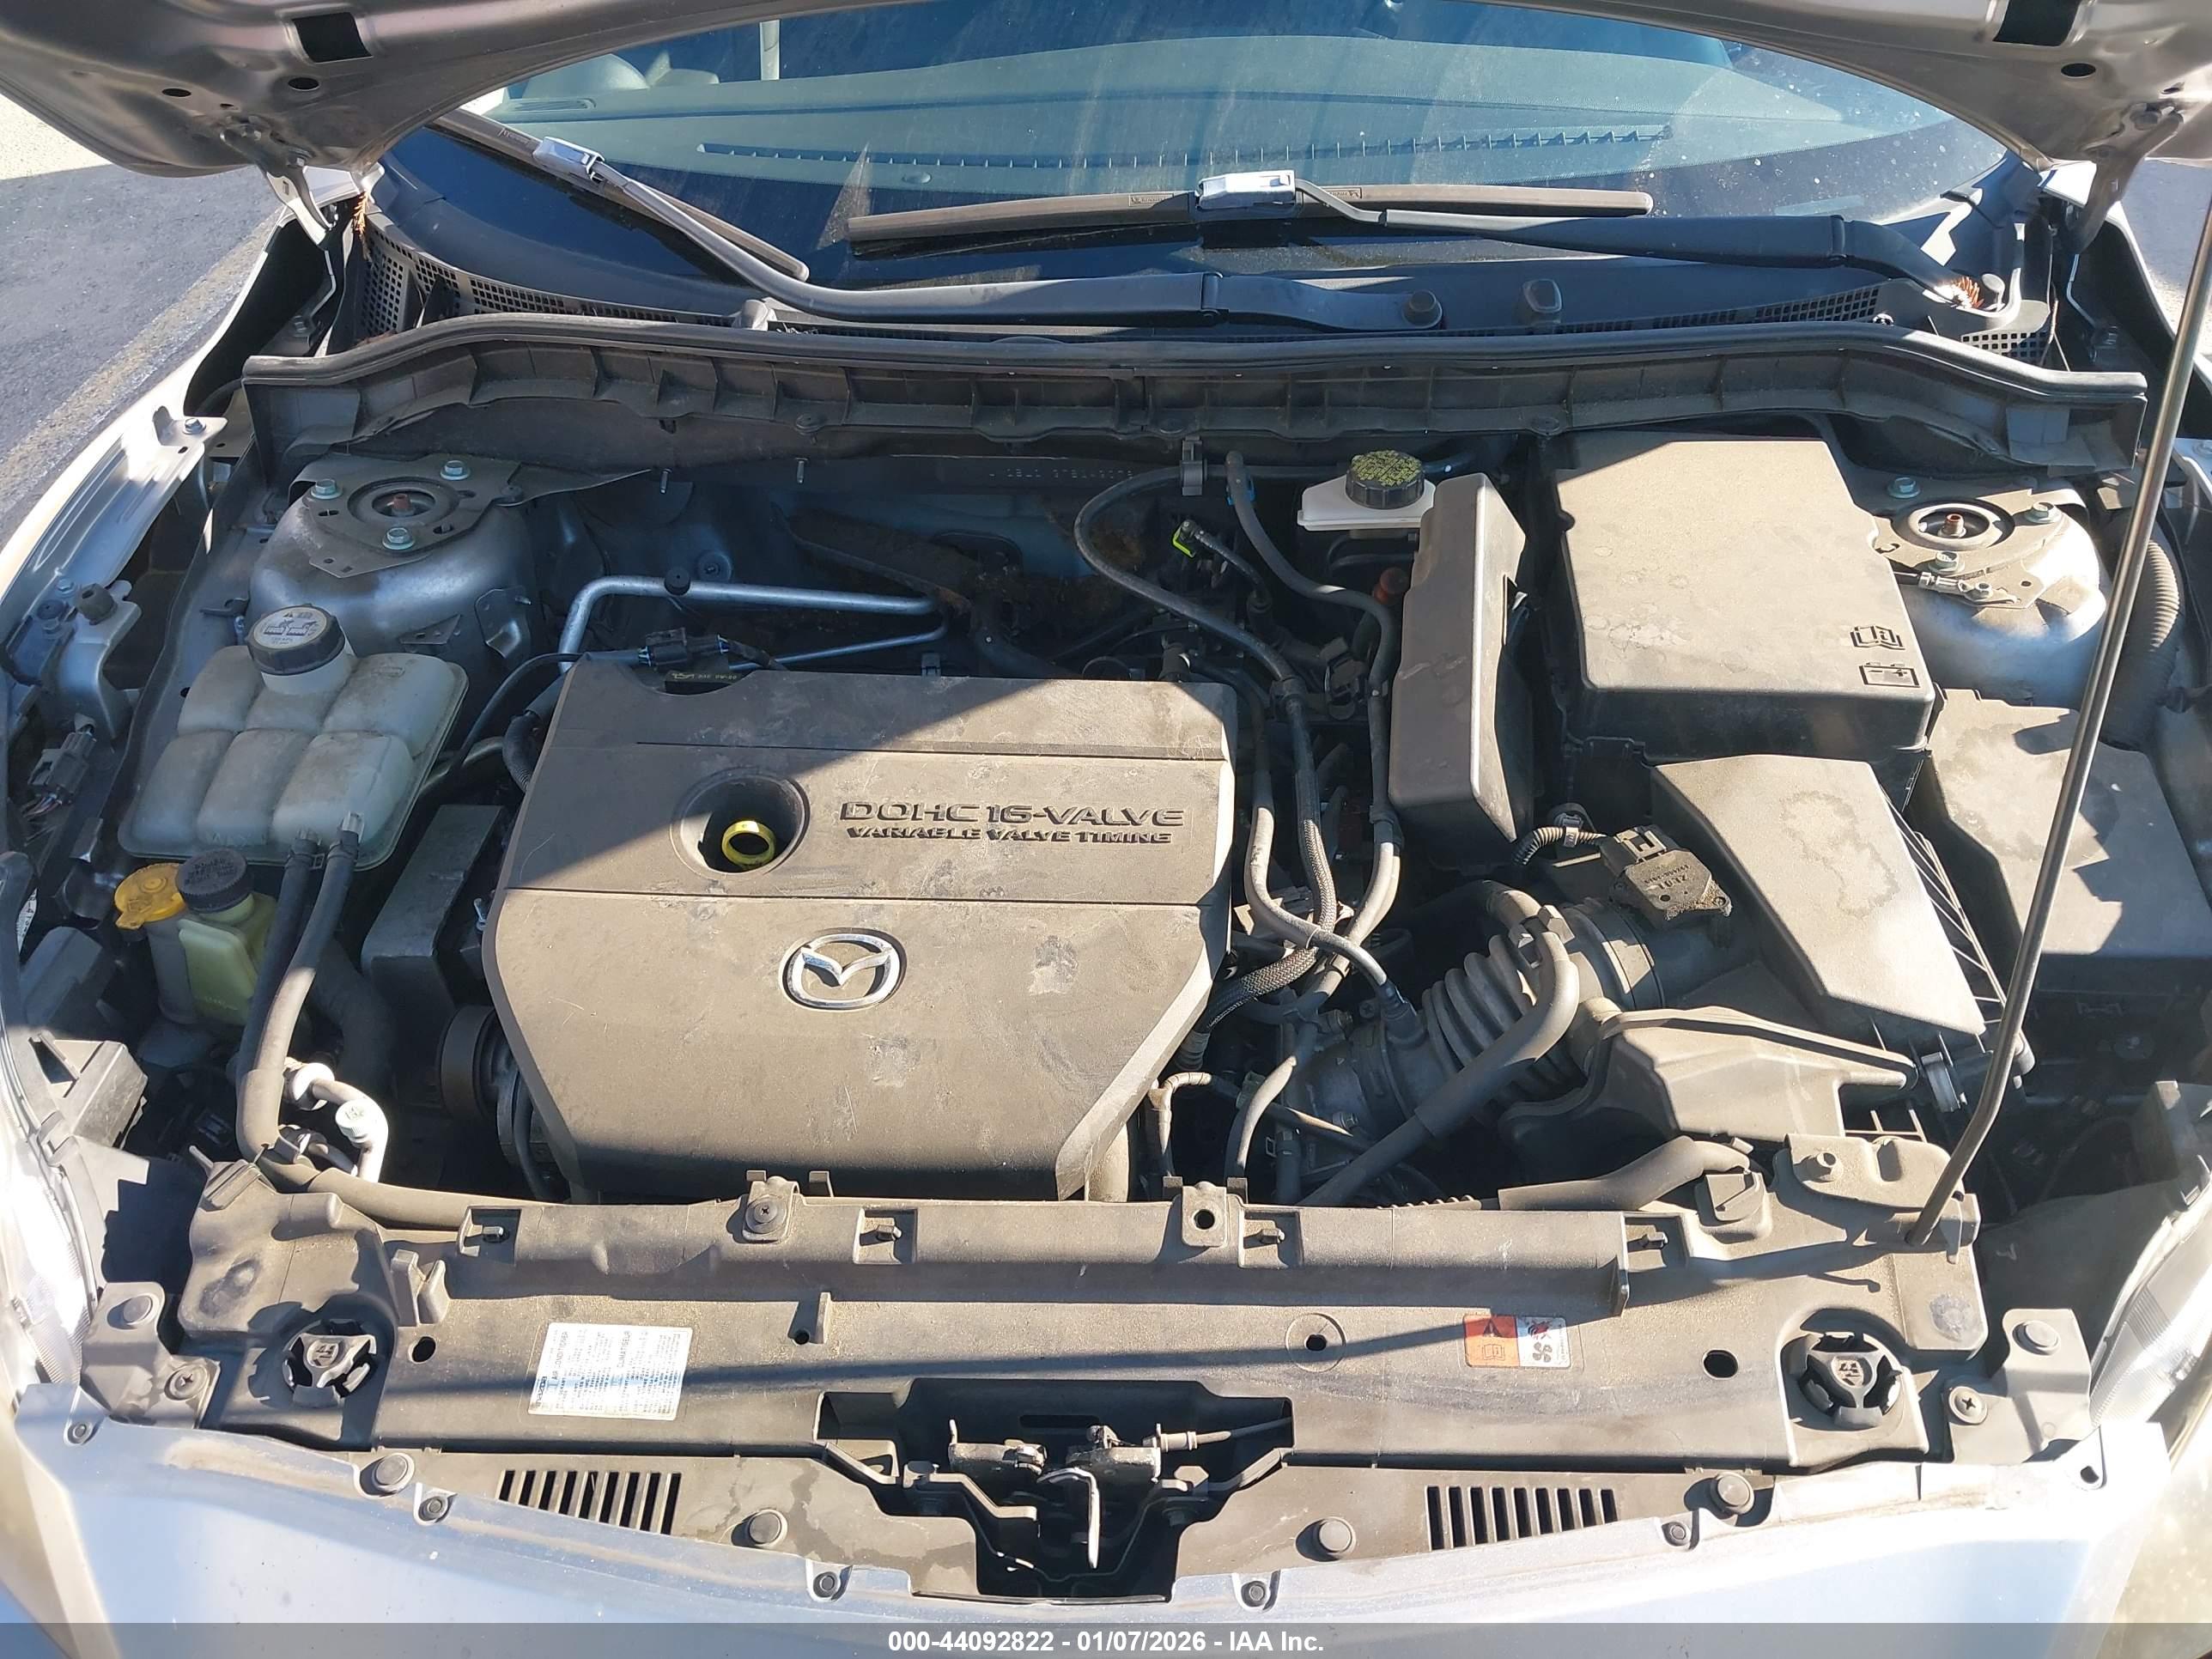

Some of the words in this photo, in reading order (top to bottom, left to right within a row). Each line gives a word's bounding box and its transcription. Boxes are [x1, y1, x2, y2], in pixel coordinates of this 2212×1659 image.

[840, 800, 980, 823] DOHC
[988, 804, 1185, 827] 16-VALVE
[846, 825, 981, 841] VARIABLE
[986, 829, 1071, 843] VALVE
[1076, 830, 1173, 845] TIMING
